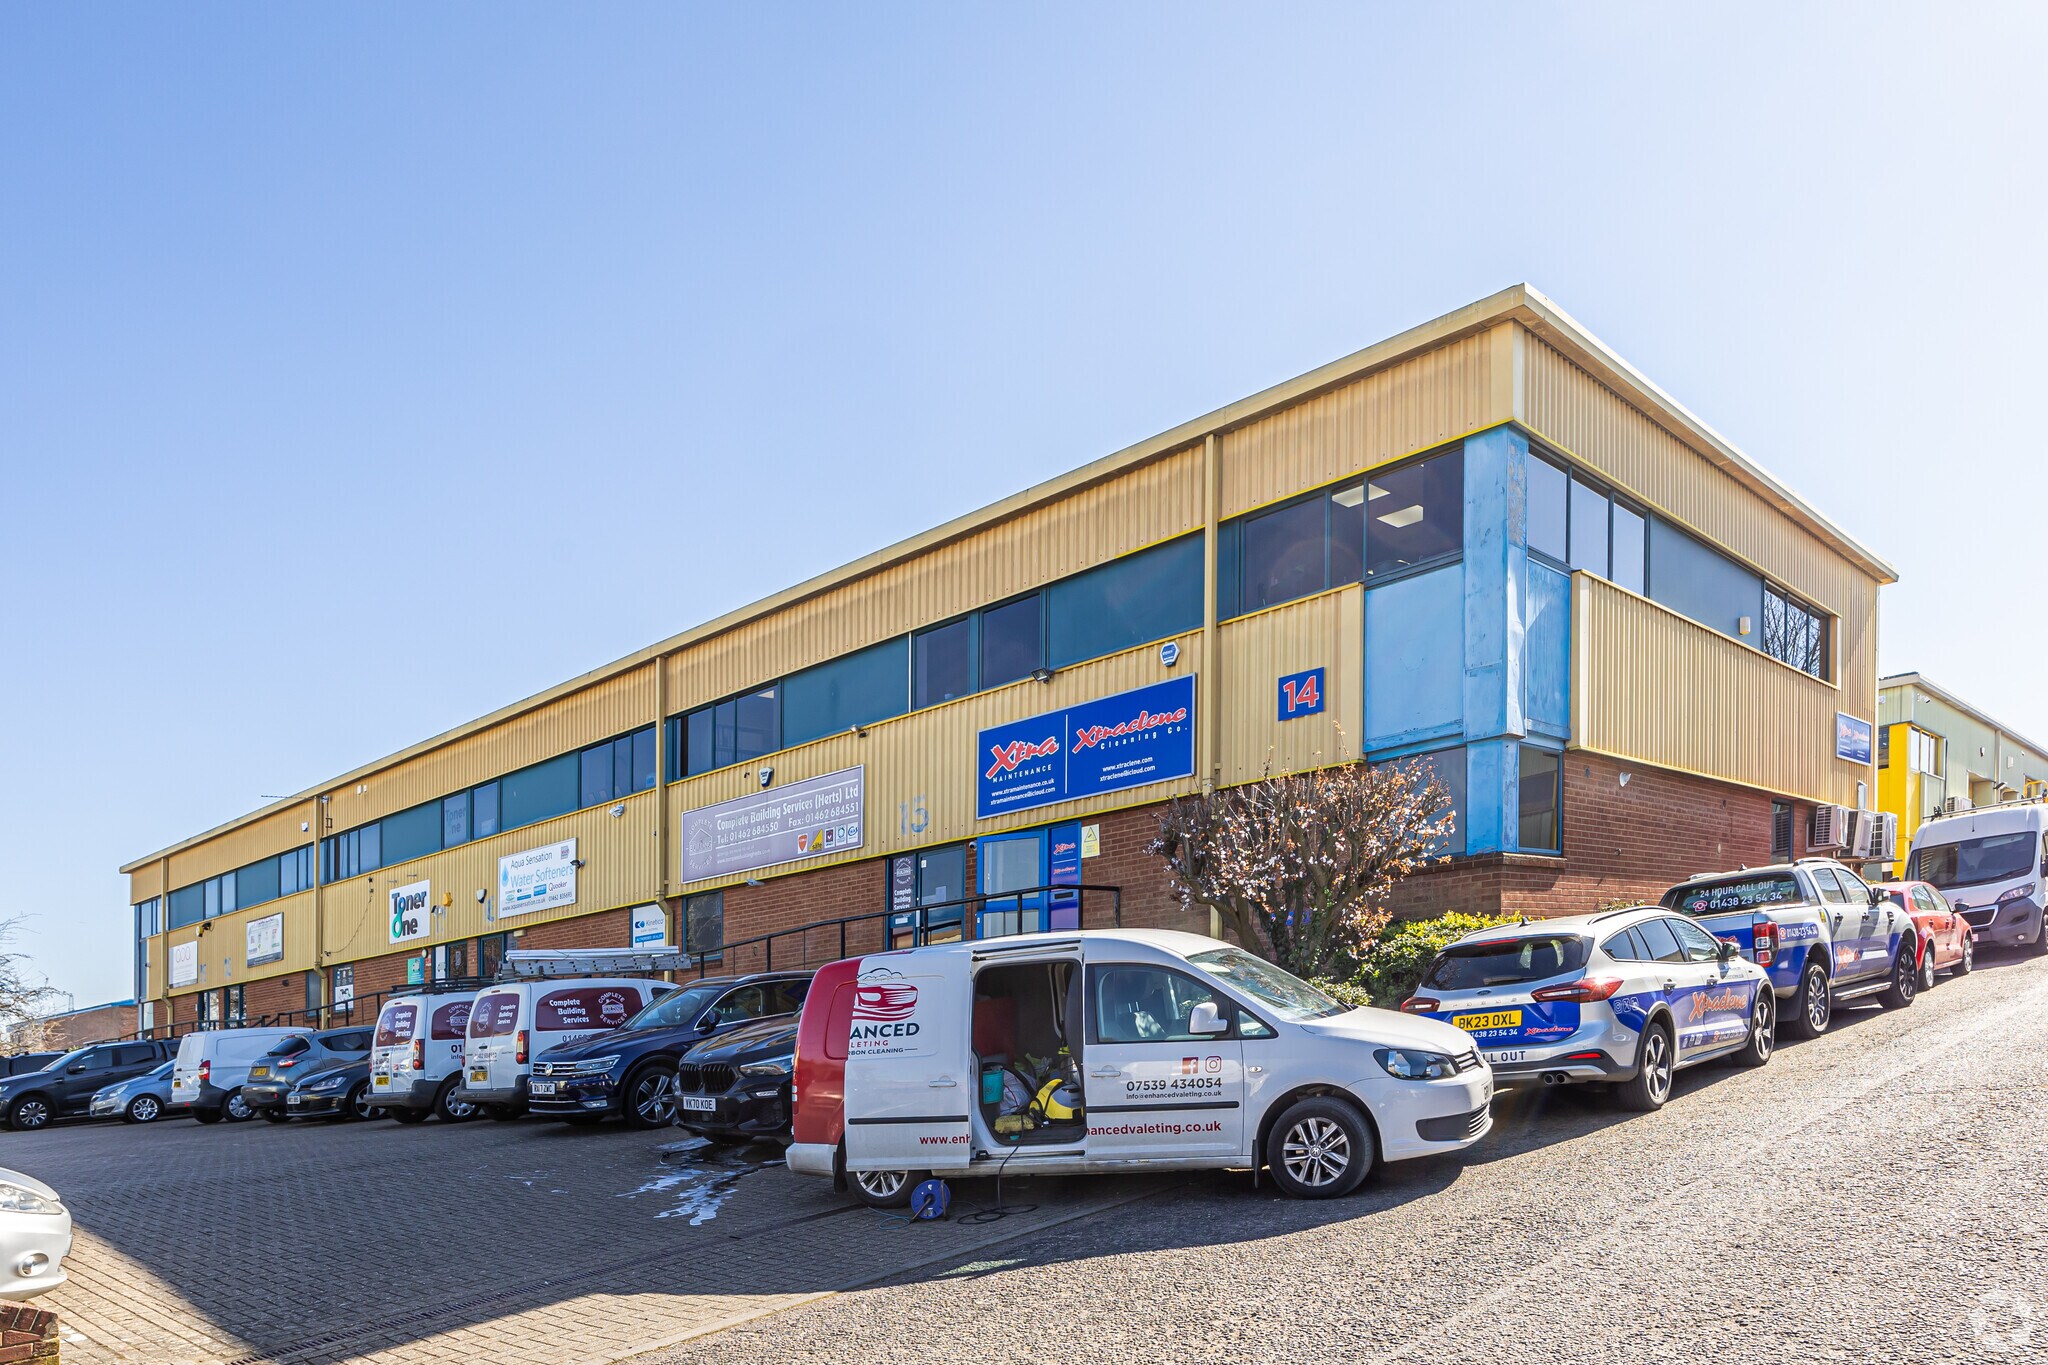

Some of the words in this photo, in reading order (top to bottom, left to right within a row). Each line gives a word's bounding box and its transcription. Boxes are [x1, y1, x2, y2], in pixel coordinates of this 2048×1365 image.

[1282, 675, 1319, 712] 14
[1072, 708, 1187, 754] Xtraclene
[1100, 731, 1157, 750] Cleaning
[1167, 726, 1188, 734] Co.
[985, 736, 1060, 780] Xtra
[1102, 756, 1153, 772] www.xtraclene.com
[992, 764, 1052, 783] MAINTENANCE
[1100, 765, 1155, 782] xtraclene@icloud.com
[990, 787, 1056, 805] xtramaintenance@icloud.com
[991, 778, 1054, 797] www.xtramaintenance.co.uk
[717, 814, 749, 830] Complete
[750, 806, 781, 823] Building
[782, 799, 813, 815] Services
[815, 788, 842, 809] (Herts)
[845, 784, 859, 799] Ltd
[717, 834, 729, 844] Tel:
[730, 828, 751, 841] 01462
[752, 821, 779, 836] 684550
[788, 817, 804, 827] Fax:
[805, 809, 829, 823] 01462
[830, 802, 859, 817] 684551
[511, 859, 525, 870] Aqua
[526, 851, 553, 866] Sensation
[511, 872, 534, 888] Water
[535, 865, 574, 883] Softeners
[1700, 890, 1709, 898] 24
[1711, 886, 1734, 896] HOUR
[1736, 882, 1756, 893] CALL
[1758, 880, 1775, 890] OUT
[391, 891, 427, 915] Toner
[1710, 897, 1739, 909] 01438
[1741, 895, 1753, 905] 23
[1755, 893, 1768, 903] 54
[1770, 891, 1782, 900] 34
[391, 917, 418, 938] One
[1836, 945, 1861, 971] Xa
[548, 998, 580, 1007] Complete
[598, 991, 626, 1004] COMPLETE
[1689, 987, 1748, 1022] Xtraclene
[562, 1016, 590, 1024] Services
[599, 1013, 628, 1025] SERVICES
[1459, 1015, 1489, 1029] BK23
[1492, 1013, 1516, 1026] OXL
[850, 1022, 920, 1039] ANCED
[1501, 1051, 1526, 1062] OUT
[1126, 1080, 1166, 1091] 07539
[1170, 1077, 1222, 1089] 434054
